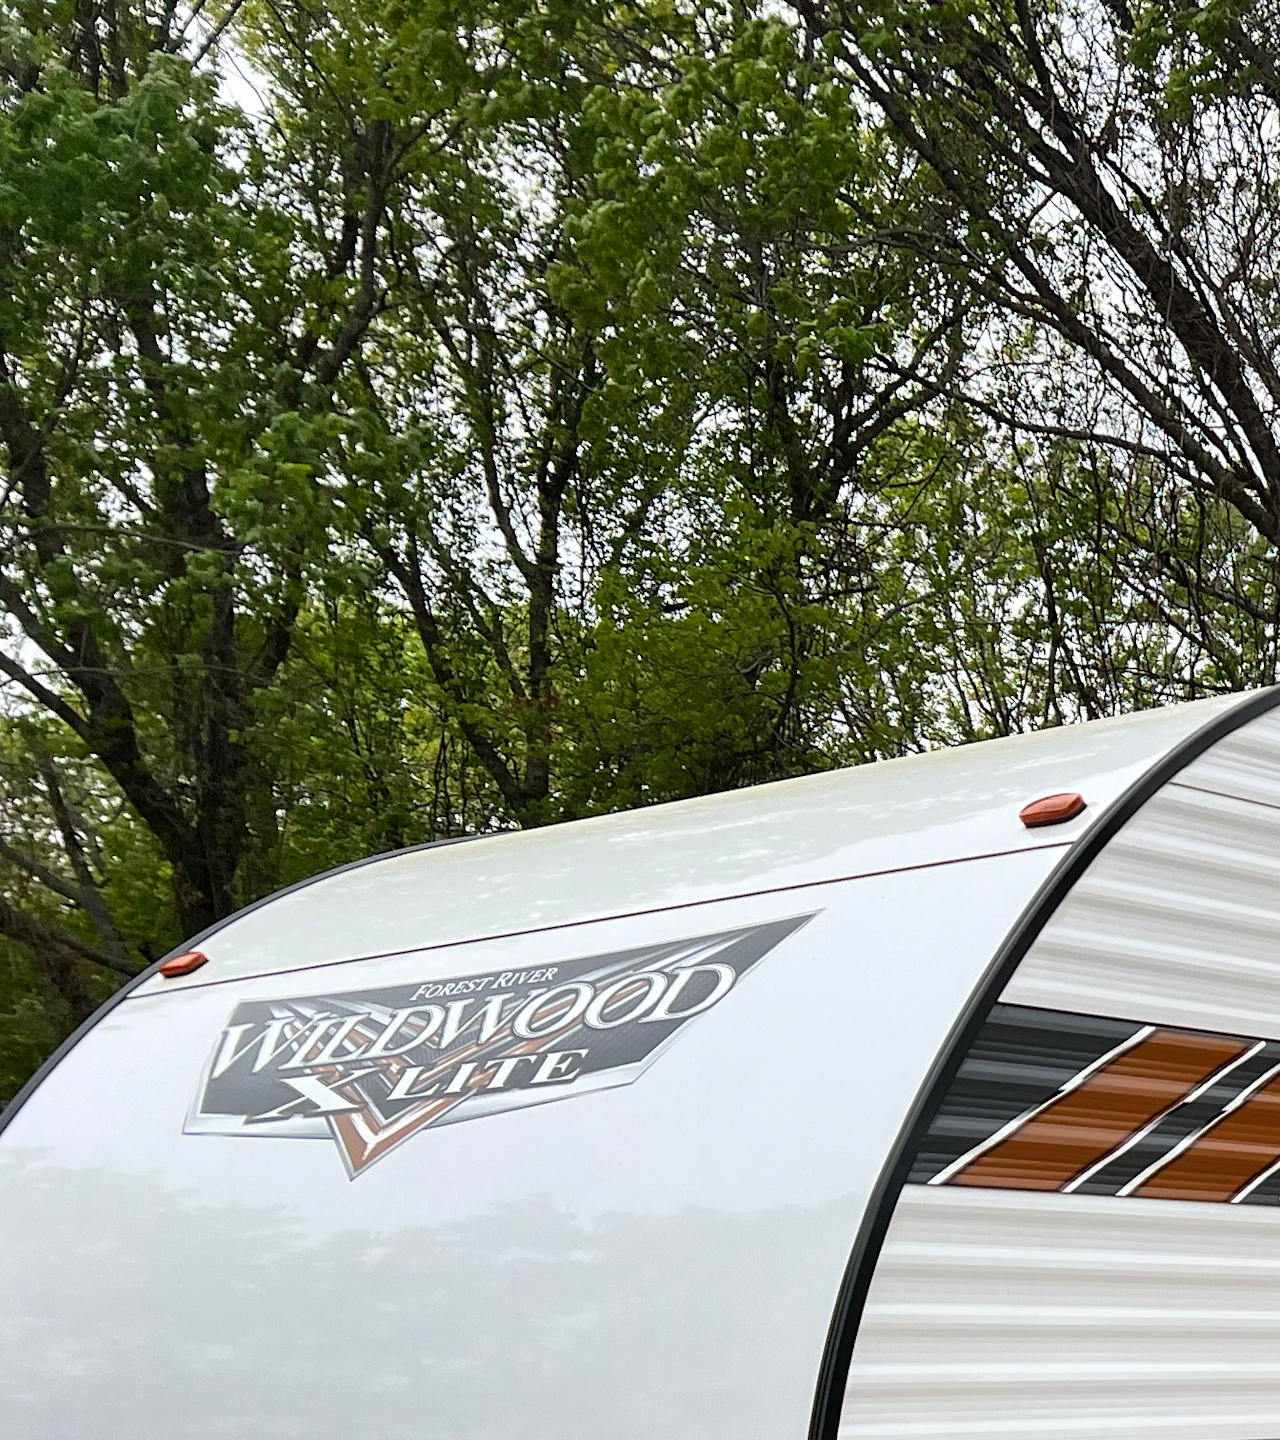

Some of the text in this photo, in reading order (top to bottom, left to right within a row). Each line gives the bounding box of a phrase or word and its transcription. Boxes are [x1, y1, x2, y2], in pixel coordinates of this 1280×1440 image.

[210, 962, 736, 1079] WILDWOOD
[410, 966, 559, 1001] FOREST RIVER
[243, 1047, 591, 1125] X LITE
